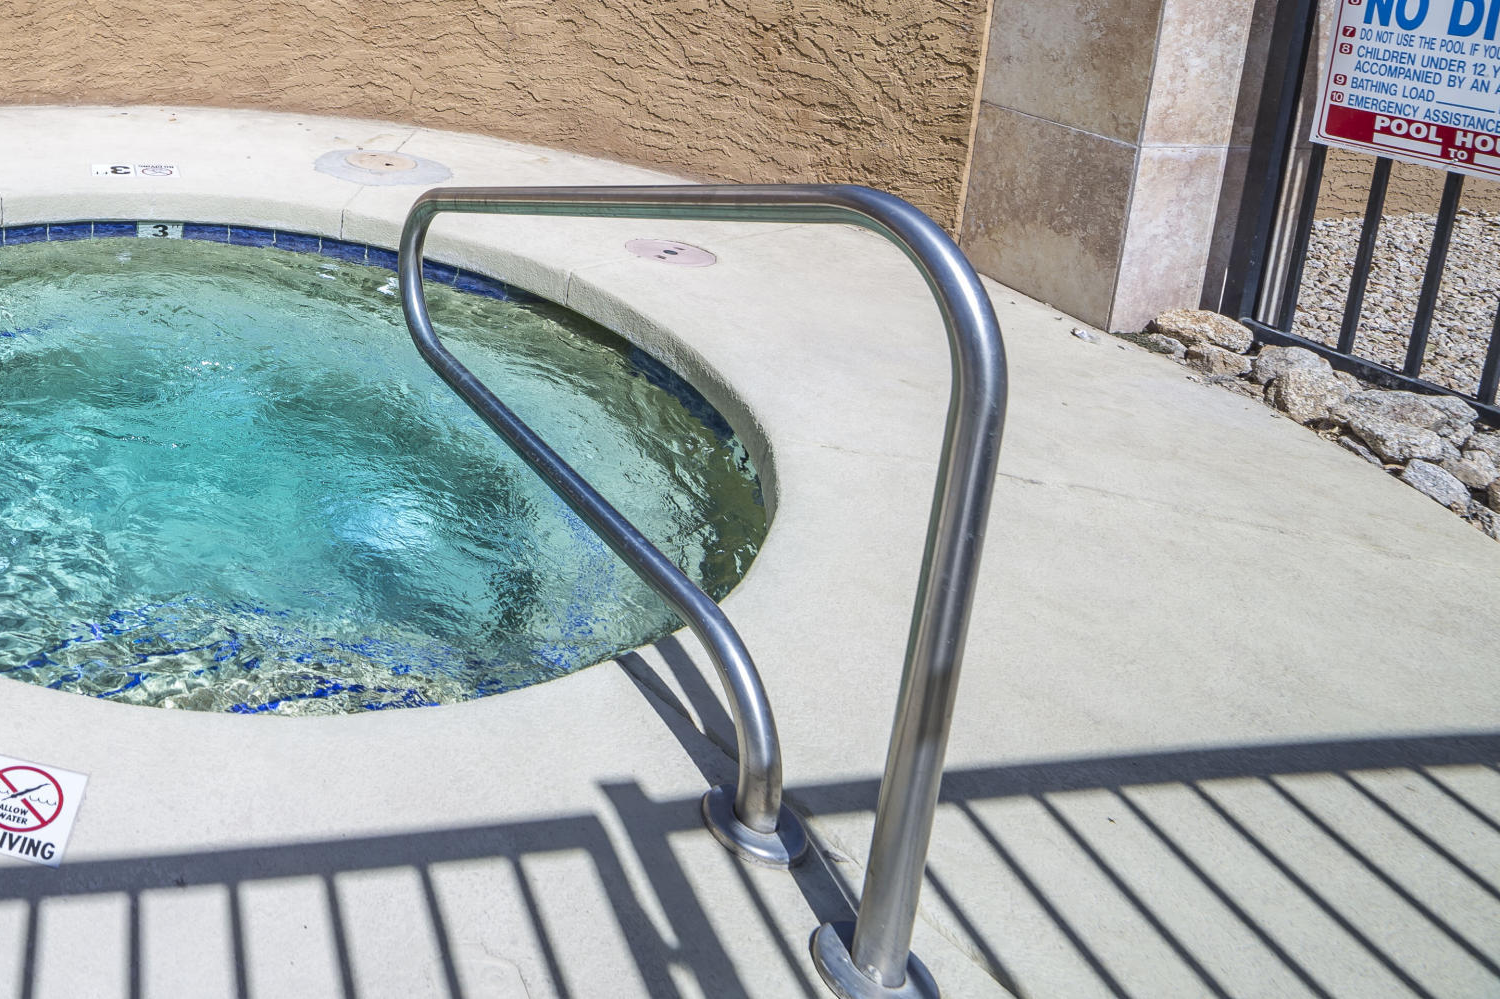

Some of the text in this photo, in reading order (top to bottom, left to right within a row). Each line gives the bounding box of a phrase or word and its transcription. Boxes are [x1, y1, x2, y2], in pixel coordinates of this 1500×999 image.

[1360, 27, 1373, 41] DO
[1375, 30, 1394, 44] NOT
[1396, 33, 1415, 47] USE
[1419, 36, 1437, 50] THE
[1439, 39, 1466, 55] POOL
[1469, 43, 1481, 56] IF
[1342, 43, 1351, 53] 8
[1356, 45, 1417, 66] CHILDREN
[1420, 55, 1467, 74] UNDER
[1472, 63, 1486, 77] 12
[1336, 75, 1435, 102] 9 BATHING LOAD
[1354, 60, 1442, 85] ACCOMPANIED
[1447, 74, 1466, 89] BY
[1470, 78, 1490, 93] AN
[1331, 92, 1500, 134] 10 EMERGENCY ASSISTANCE
[1374, 115, 1443, 143] POOL
[1448, 148, 1468, 161] TO
[152, 223, 169, 237] 3
